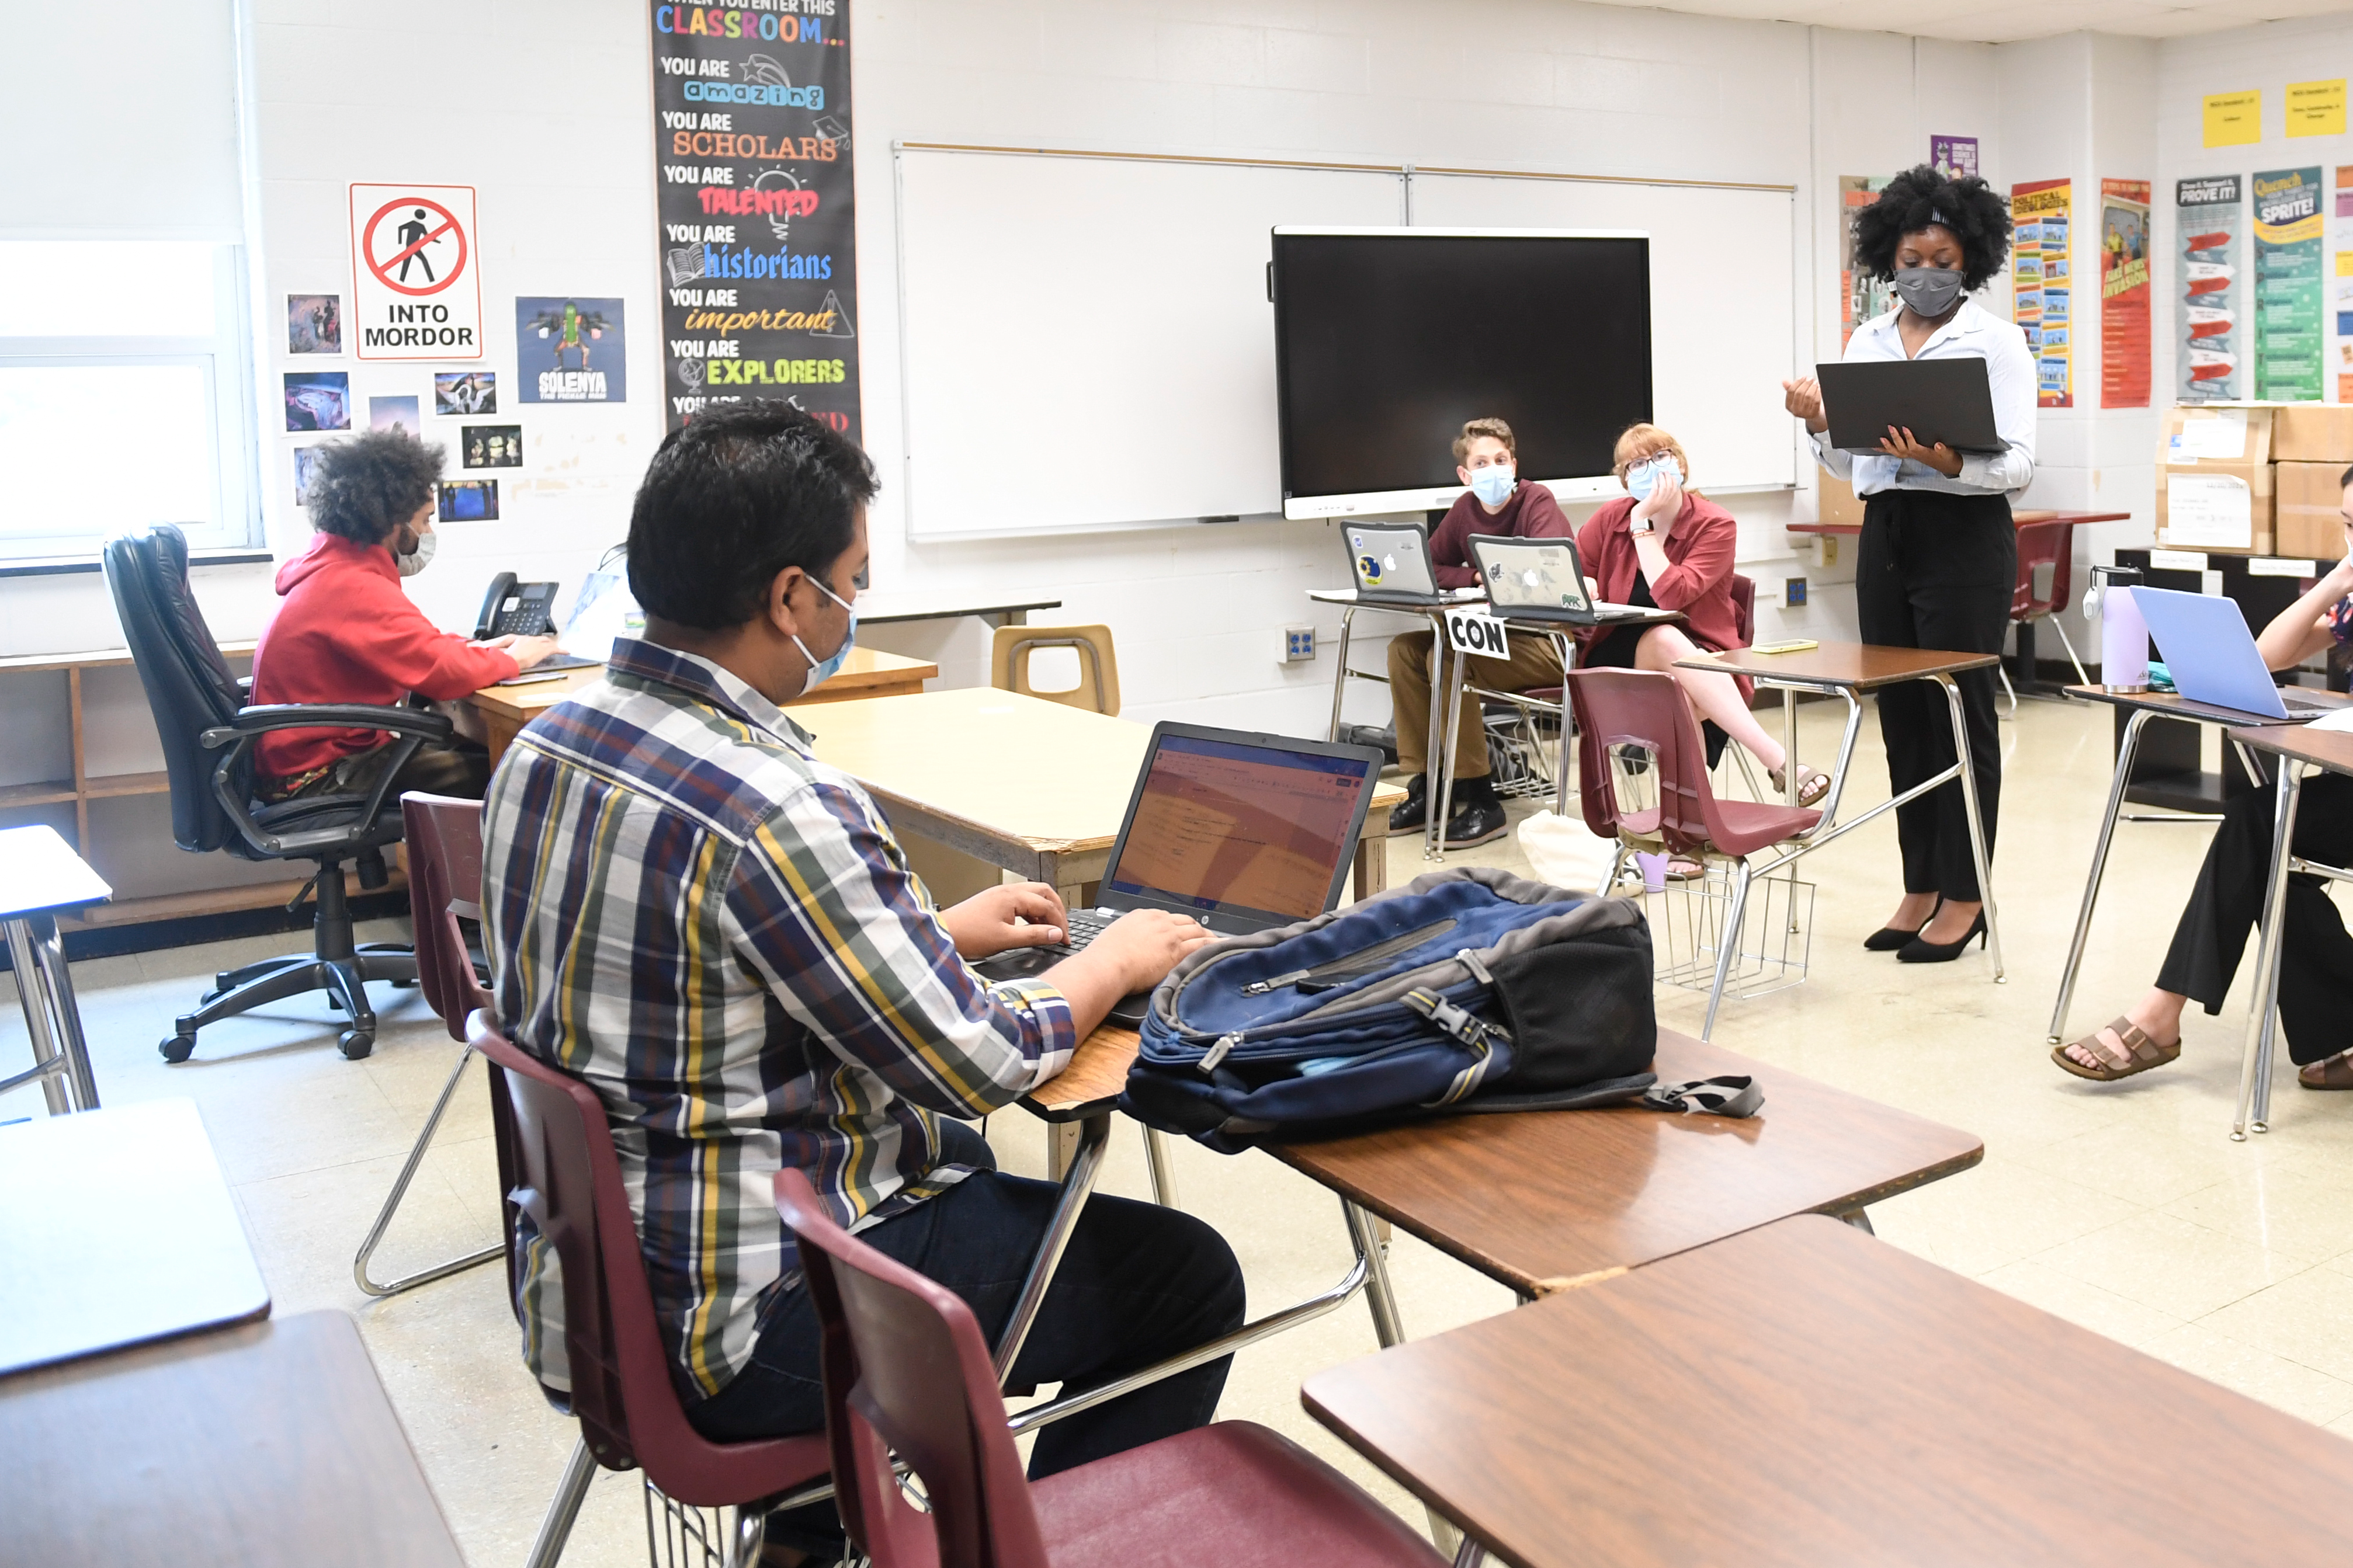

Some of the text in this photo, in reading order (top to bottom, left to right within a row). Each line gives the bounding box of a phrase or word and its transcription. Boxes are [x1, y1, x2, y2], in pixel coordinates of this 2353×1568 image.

[751, 0, 799, 12] ENTER
[801, 0, 835, 16] THIS
[656, 5, 845, 46] CLASSROOM...
[661, 57, 730, 77] YOU ARE
[685, 83, 823, 109] amazing
[662, 111, 731, 131] YOU ARE
[673, 131, 837, 162] SCHOLARS
[664, 165, 734, 185] YOU ARE
[698, 186, 819, 217] TALENTED
[2180, 186, 2236, 203] PROVE IT!
[2261, 197, 2314, 223] SPRITE!
[667, 224, 736, 243] YOU ARE
[704, 242, 832, 279] historians
[669, 289, 738, 307] YOU ARE
[388, 305, 449, 324] INTO
[685, 308, 838, 338] important
[365, 327, 474, 347] MORDOR
[671, 340, 740, 357] YOU ARE
[539, 371, 607, 392] SOLENYA
[707, 359, 845, 384] EXPLORERS
[1451, 616, 1505, 654] CON
